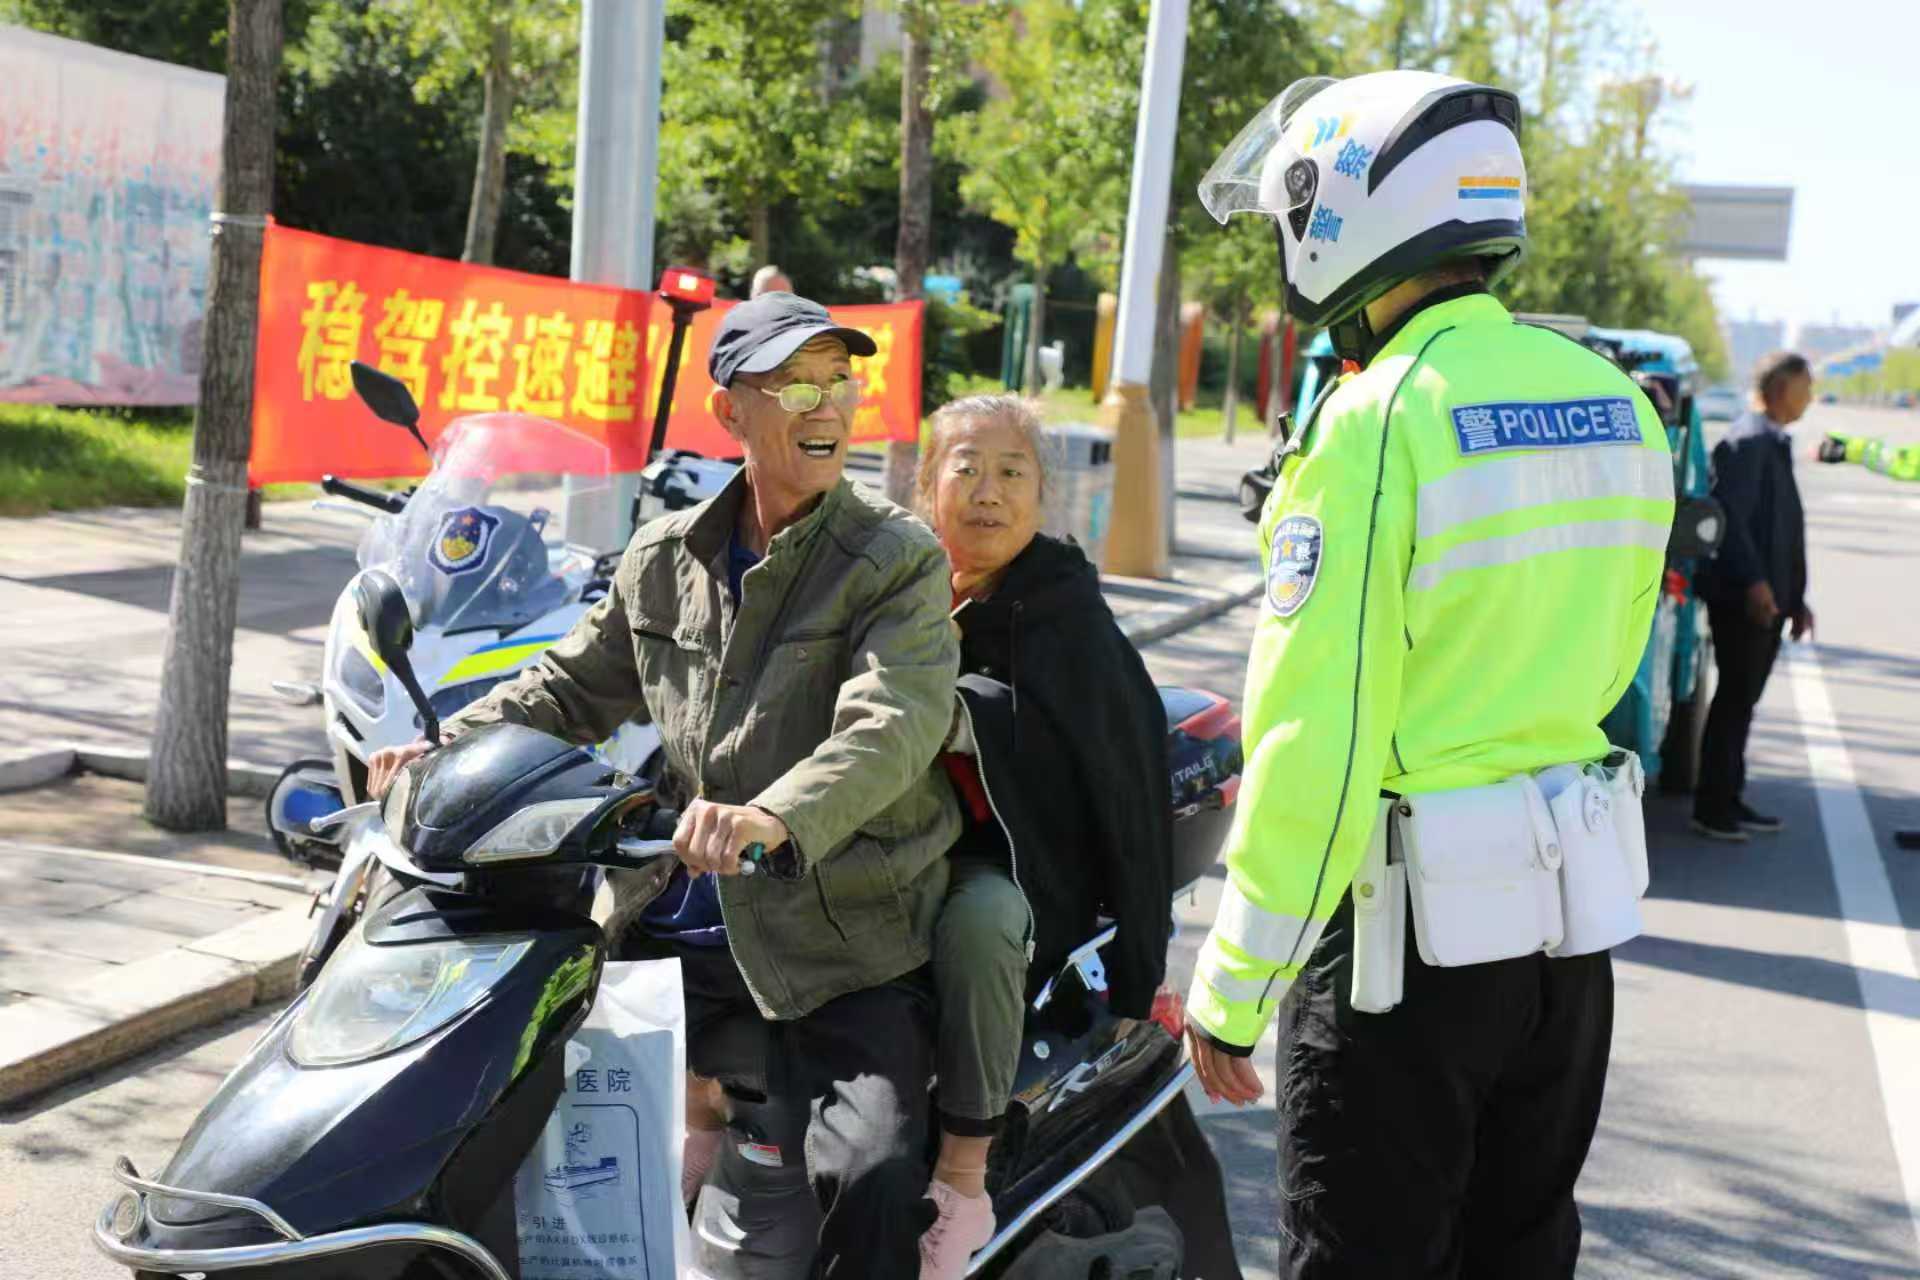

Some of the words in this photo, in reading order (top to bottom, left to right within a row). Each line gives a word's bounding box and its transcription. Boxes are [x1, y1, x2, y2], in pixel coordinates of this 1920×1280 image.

[298, 280, 694, 421] 稳驾控速避
[562, 1067, 632, 1093] 医院
